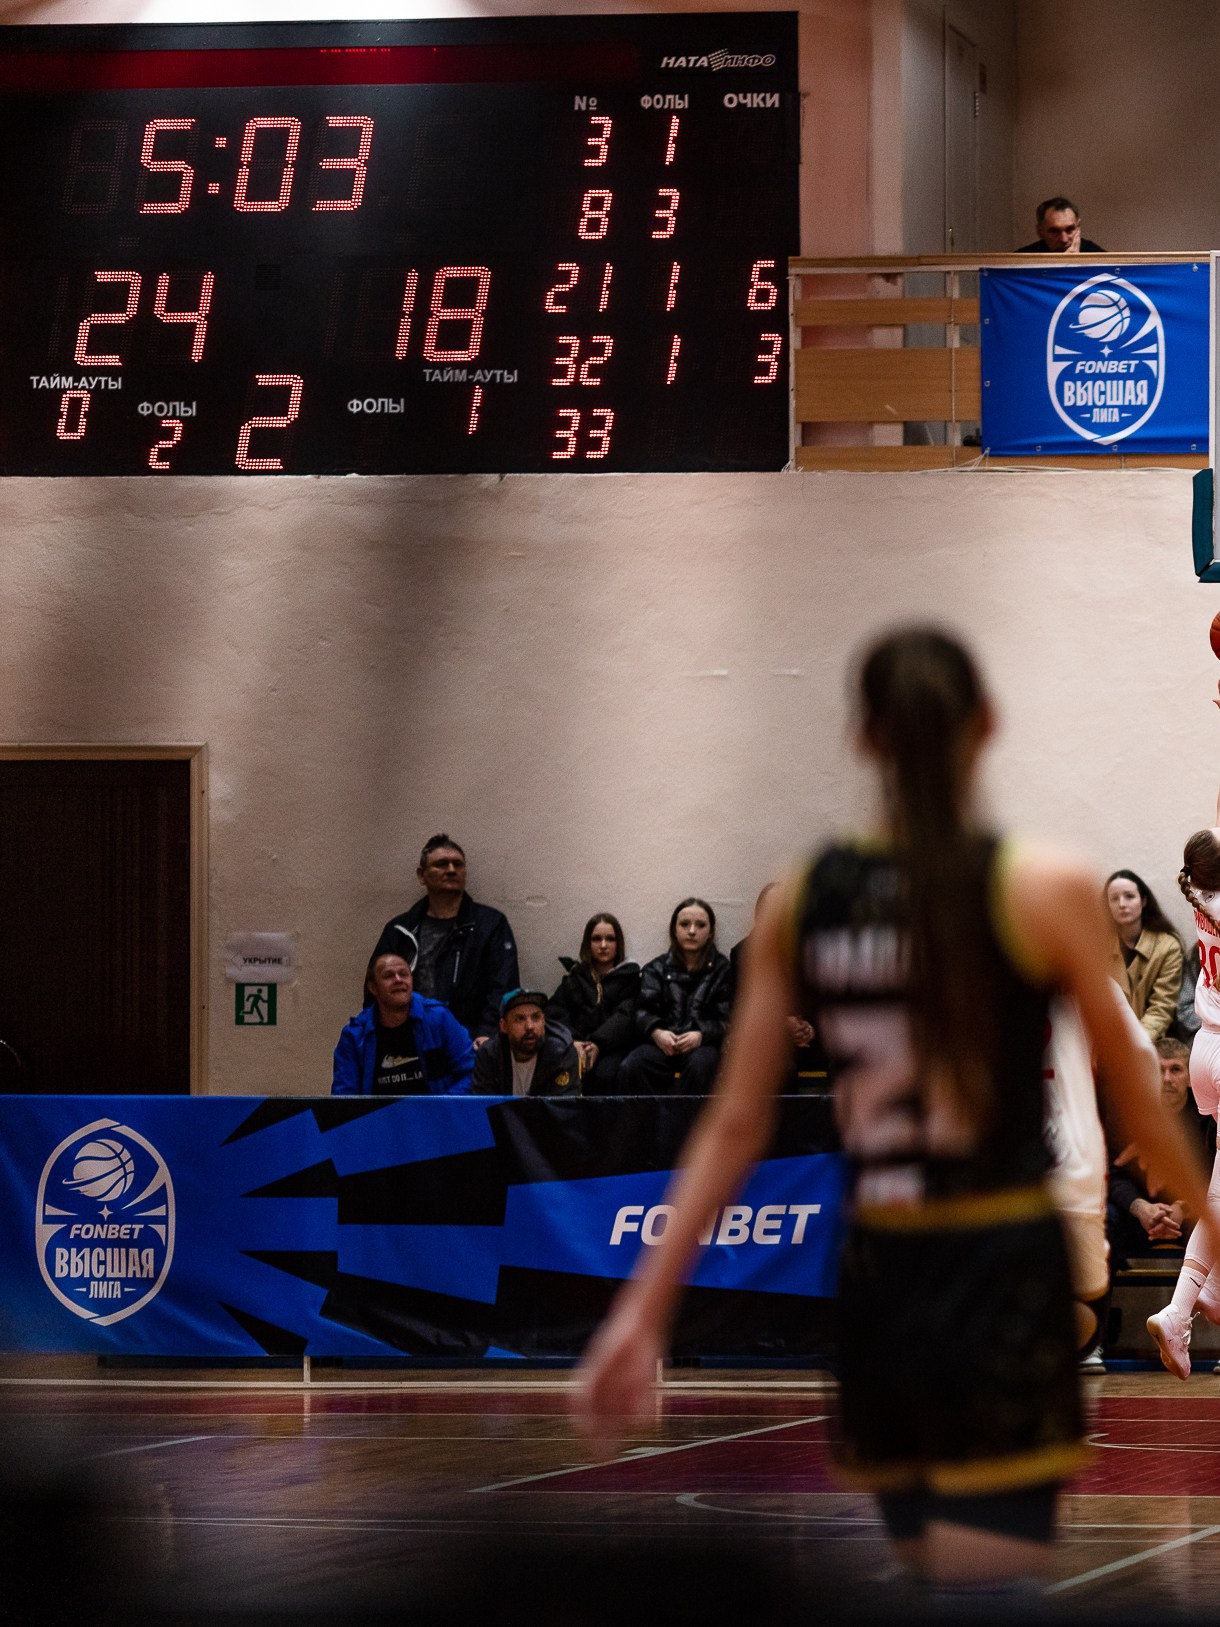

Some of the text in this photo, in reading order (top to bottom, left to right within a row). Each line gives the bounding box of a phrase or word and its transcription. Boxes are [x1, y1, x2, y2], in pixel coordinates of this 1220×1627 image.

[660, 56, 709, 68] НАТА
[640, 94, 689, 109] ФОЛЫ
[723, 93, 780, 108] ОЧКИ
[139, 116, 374, 213] 5:03
[583, 116, 612, 167] 3
[664, 115, 680, 166] 1
[578, 189, 613, 239] 8
[651, 188, 680, 238] 3
[545, 262, 613, 313] 21
[665, 261, 681, 311] 1
[747, 260, 777, 310] 6
[74, 271, 214, 366] 24
[395, 266, 491, 361] 18
[30, 373, 122, 390] ТАЙМ-АУТЫ
[423, 367, 518, 383] ТАЙМ-АУТЫ
[551, 335, 614, 385] 32
[666, 334, 681, 385] 1
[753, 333, 782, 384] 3
[1075, 360, 1139, 374] FONBET
[56, 390, 90, 439] 0
[137, 401, 197, 417] ФОЛЫ
[347, 398, 405, 413] ФОЛЫ
[467, 385, 482, 435] 1
[1063, 380, 1148, 406] ВЫСШАЯ
[1092, 407, 1120, 423] ЛИГА
[148, 419, 183, 469] 2
[235, 374, 303, 470] 2
[551, 408, 614, 459] 33
[243, 957, 283, 965] УКРЫТИЕ
[69, 1223, 144, 1239] FONBET
[55, 1247, 155, 1278] ВЫСШАЯ
[89, 1281, 121, 1298] ЛИГА
